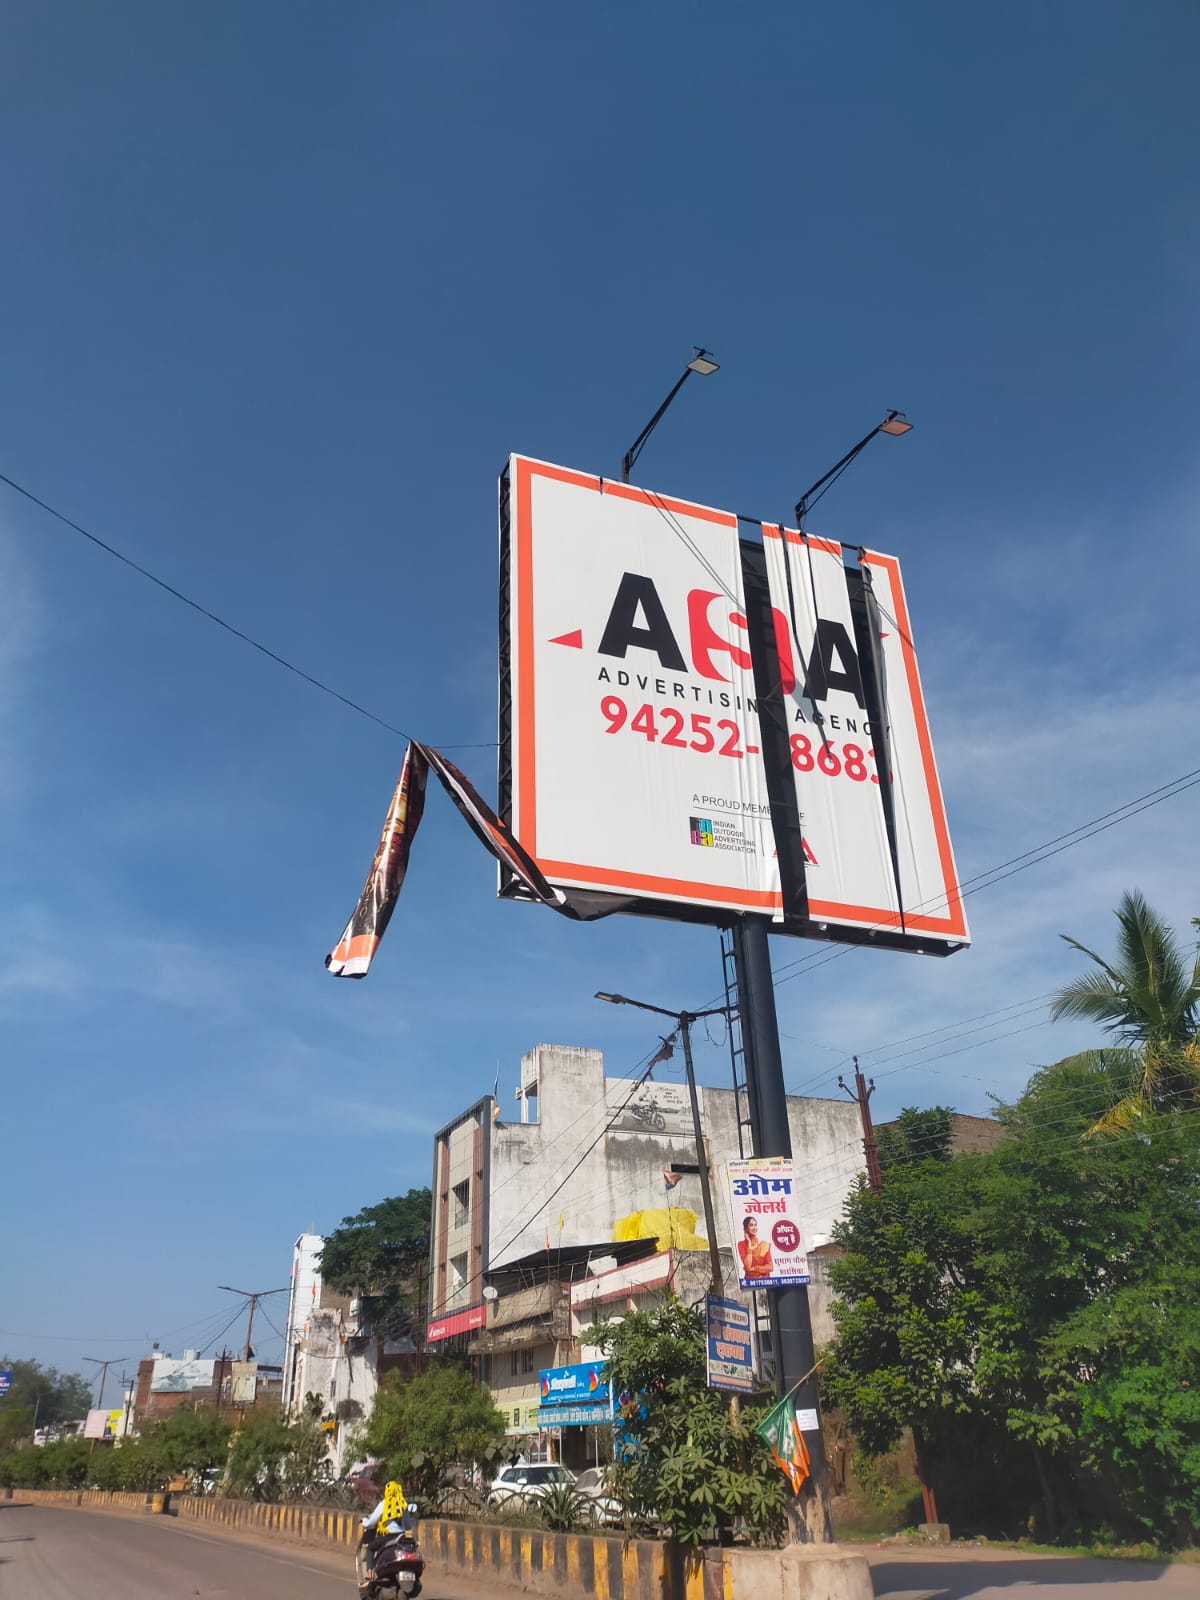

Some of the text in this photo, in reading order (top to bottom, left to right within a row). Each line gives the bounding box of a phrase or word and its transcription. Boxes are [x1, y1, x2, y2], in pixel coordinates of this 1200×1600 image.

[598, 666, 759, 713] ADVERTISIN
[692, 793, 700, 803] A
[702, 795, 741, 811] PROUD
[713, 820, 736, 830] INDIAN
[713, 828, 745, 839] OUTDOOR
[714, 835, 757, 847] ADVERTISING
[714, 842, 757, 854] ASSOCIATION
[733, 1173, 793, 1196] ओम
